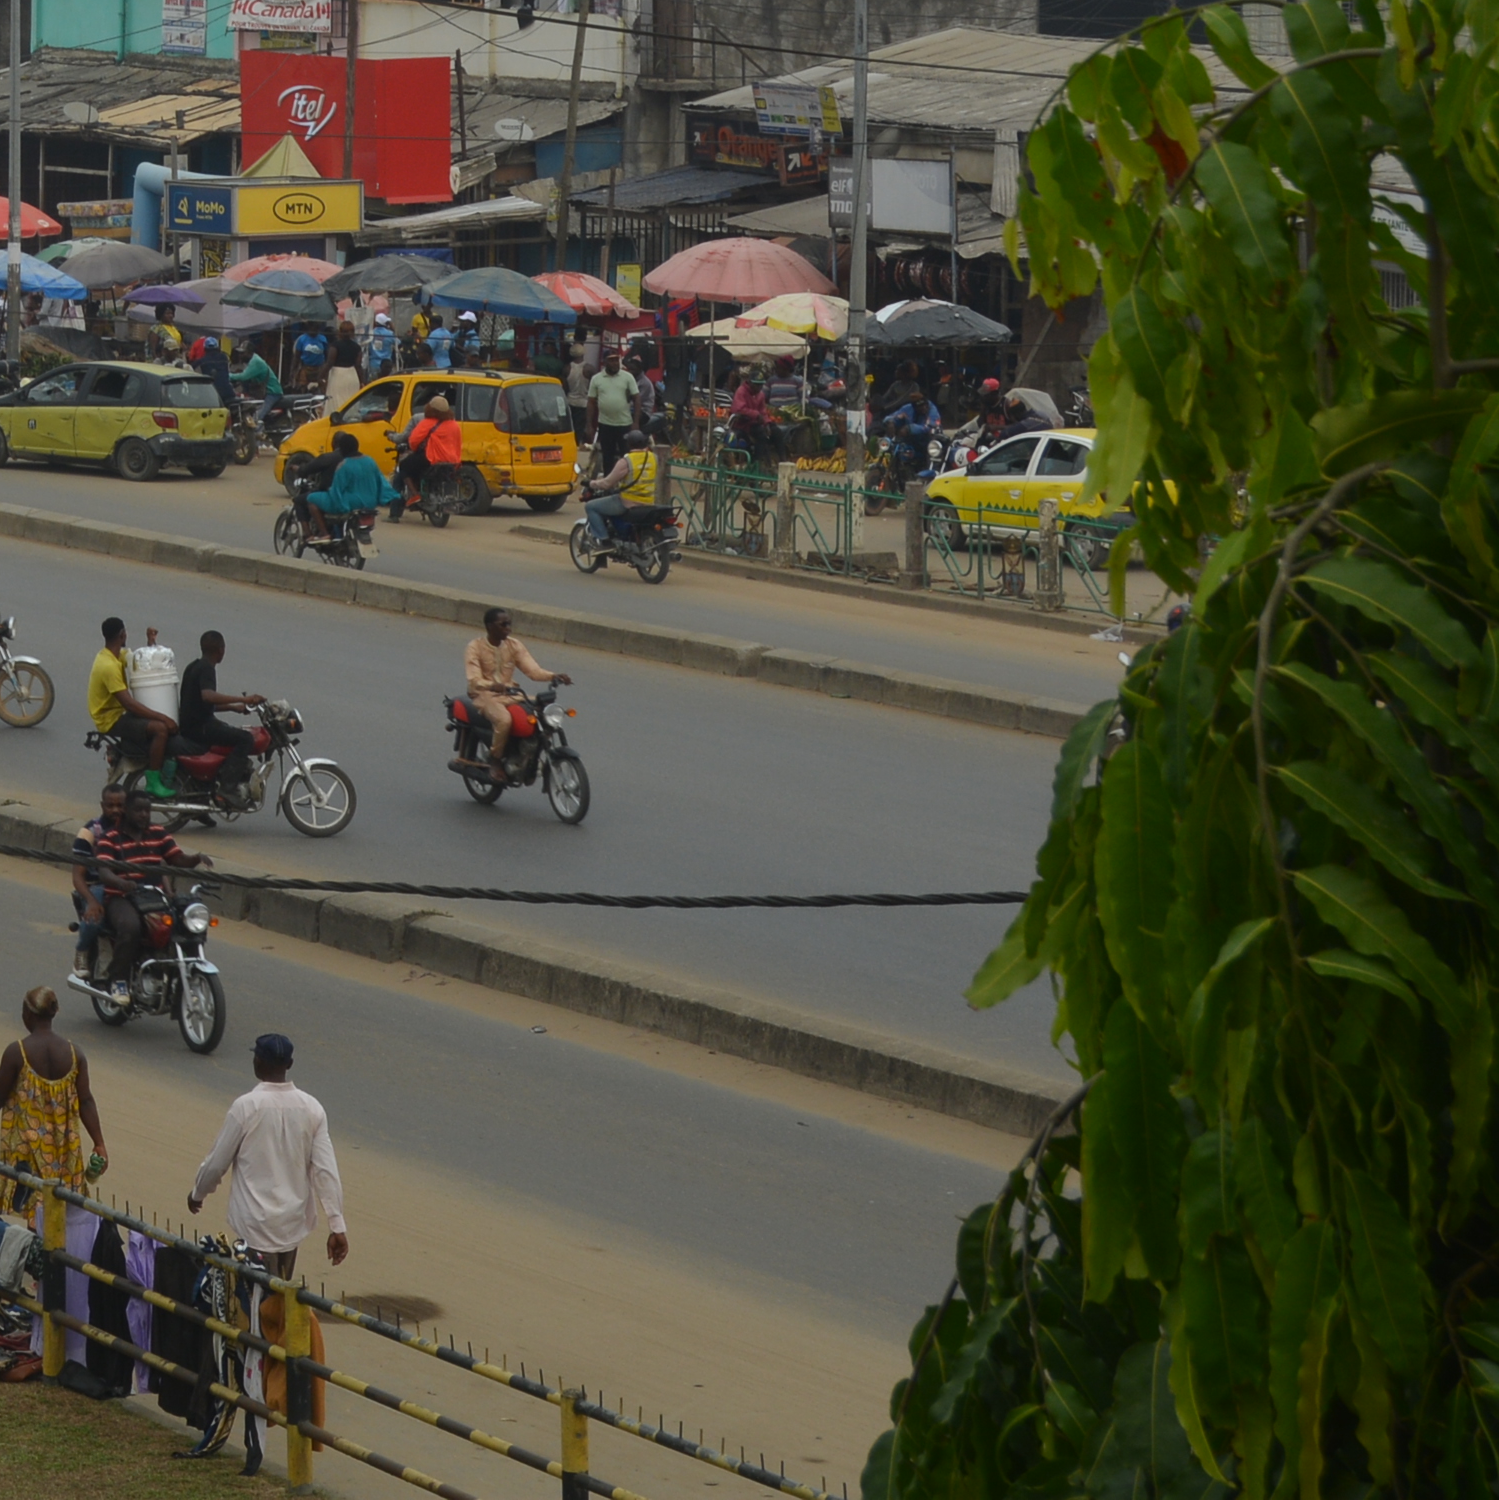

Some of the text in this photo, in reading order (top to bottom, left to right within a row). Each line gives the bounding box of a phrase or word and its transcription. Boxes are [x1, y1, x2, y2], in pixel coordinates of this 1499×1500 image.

[248, 0, 314, 19] Canada
[291, 92, 325, 119] itel
[196, 200, 225, 215] MoMo
[285, 203, 312, 215] MTN
